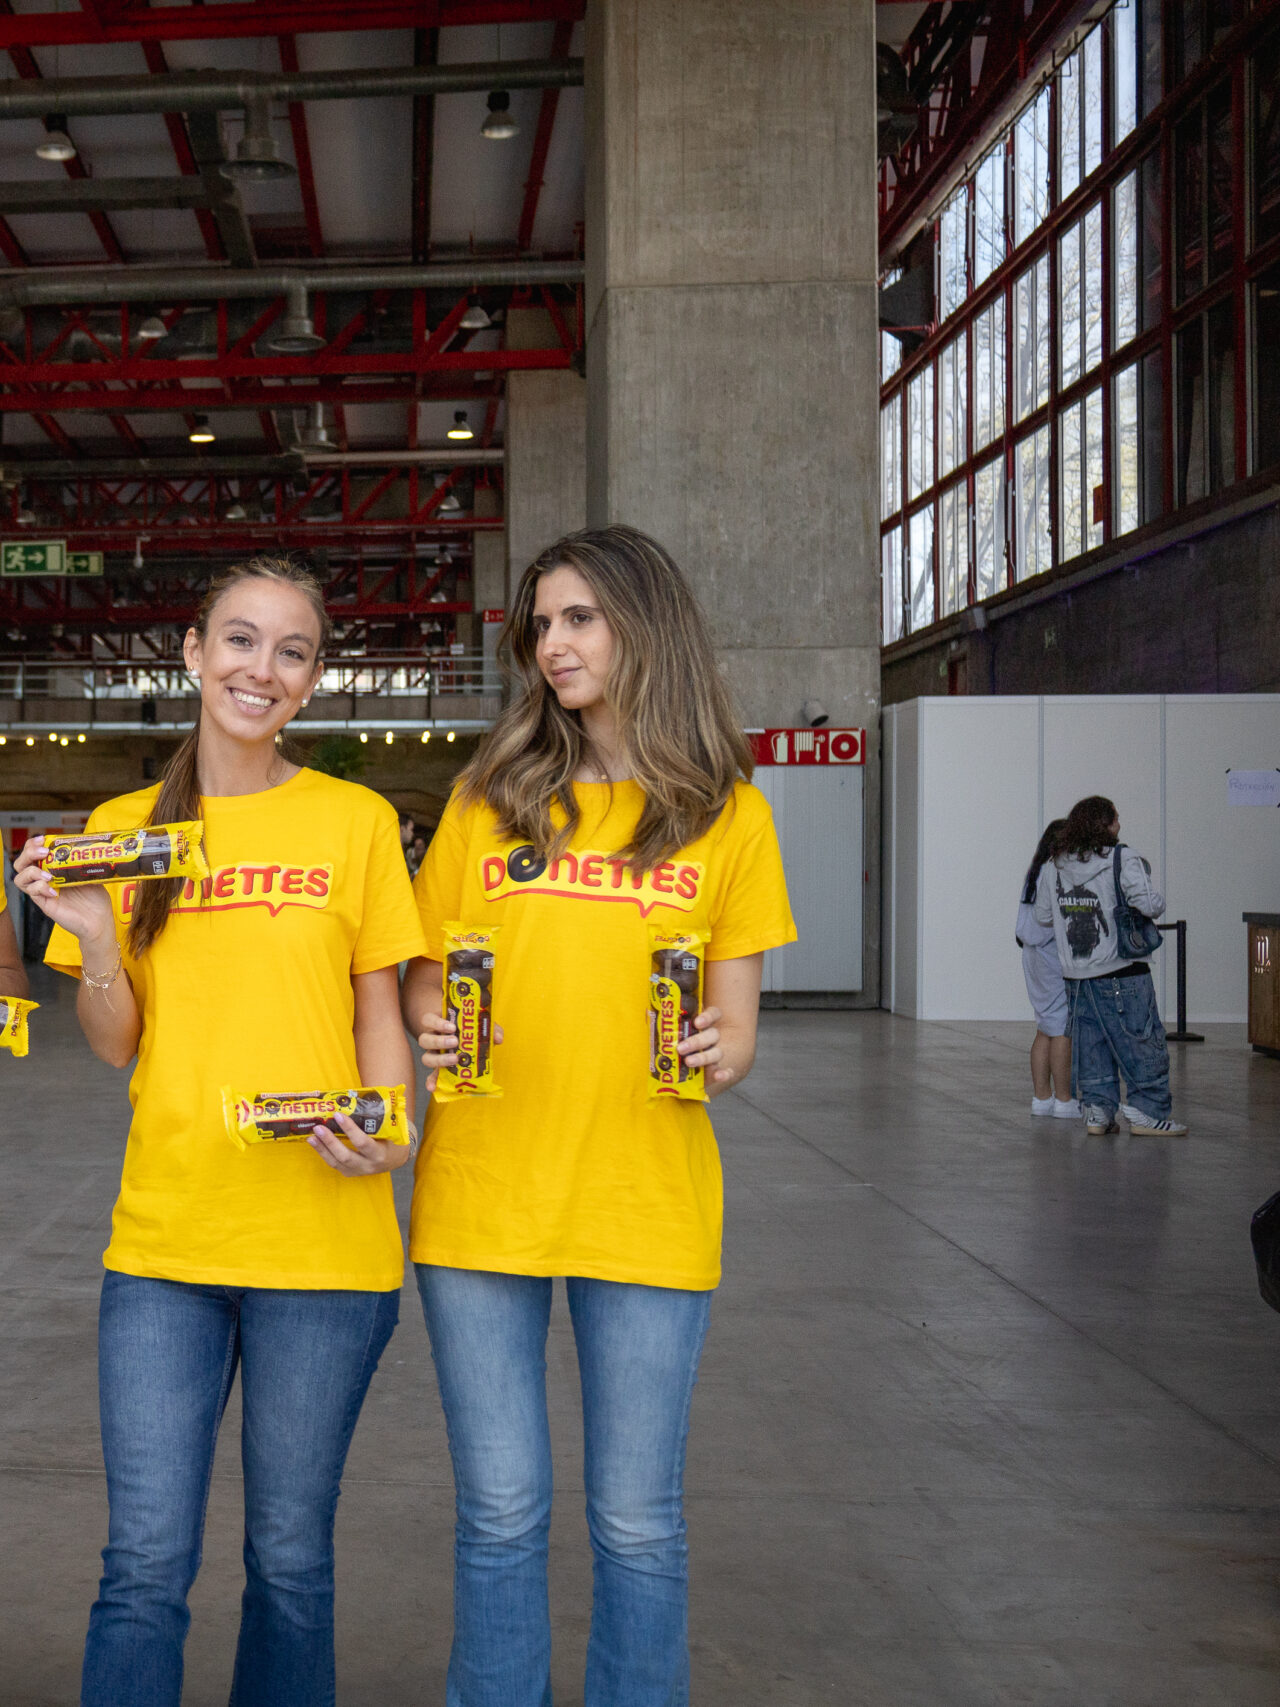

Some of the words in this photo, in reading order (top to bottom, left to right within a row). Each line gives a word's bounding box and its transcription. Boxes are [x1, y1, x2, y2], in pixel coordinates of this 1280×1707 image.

[45, 844, 122, 866] DONETTES
[457, 999, 475, 1079] DONETTES
[659, 1000, 675, 1083] DONETTES
[253, 1101, 336, 1117] DONETTES
